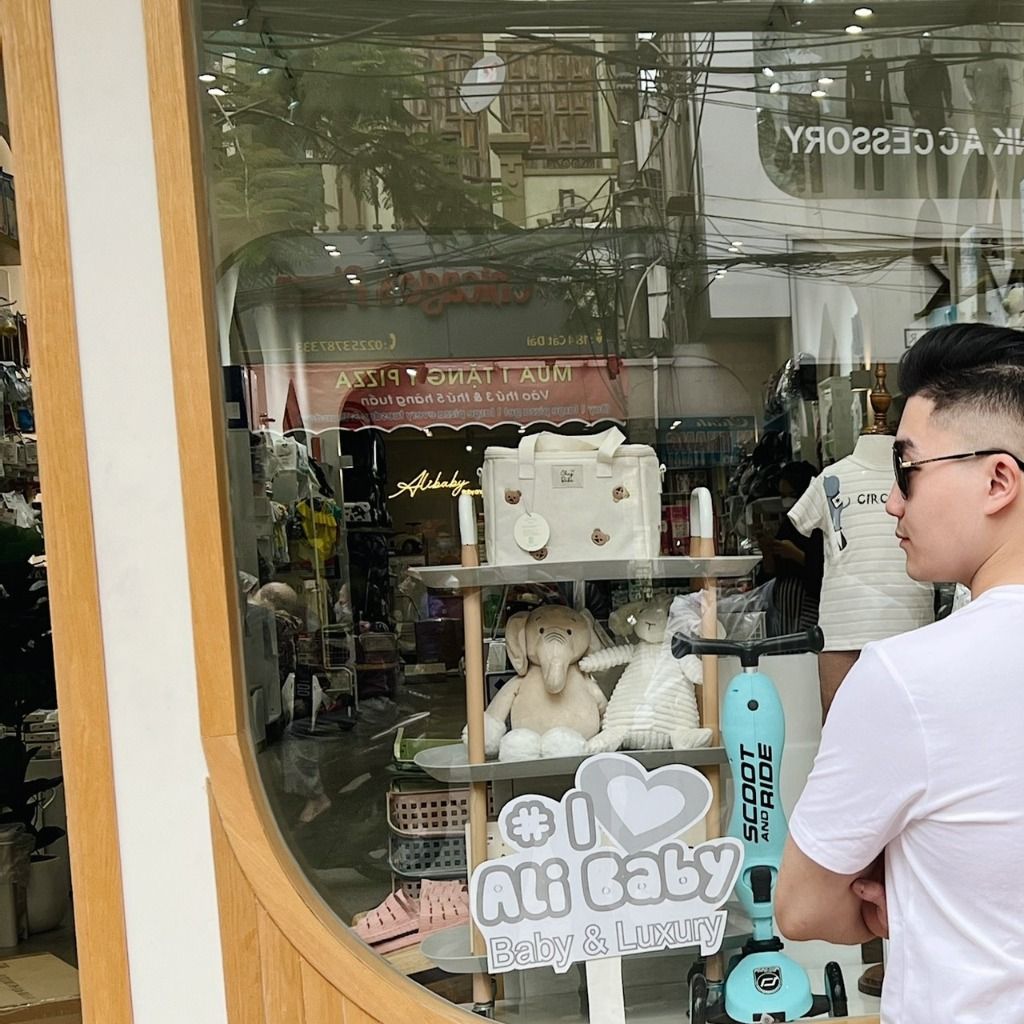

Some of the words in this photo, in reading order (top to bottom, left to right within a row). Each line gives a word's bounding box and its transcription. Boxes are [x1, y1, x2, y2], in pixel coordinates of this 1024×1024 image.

[740, 744, 759, 843] SCOOT
[758, 742, 775, 810] RIDE
[760, 810, 769, 842] AND
[581, 842, 742, 912] Baby
[490, 931, 574, 969] Baby
[583, 924, 609, 956] &
[616, 914, 723, 951] Luxury
